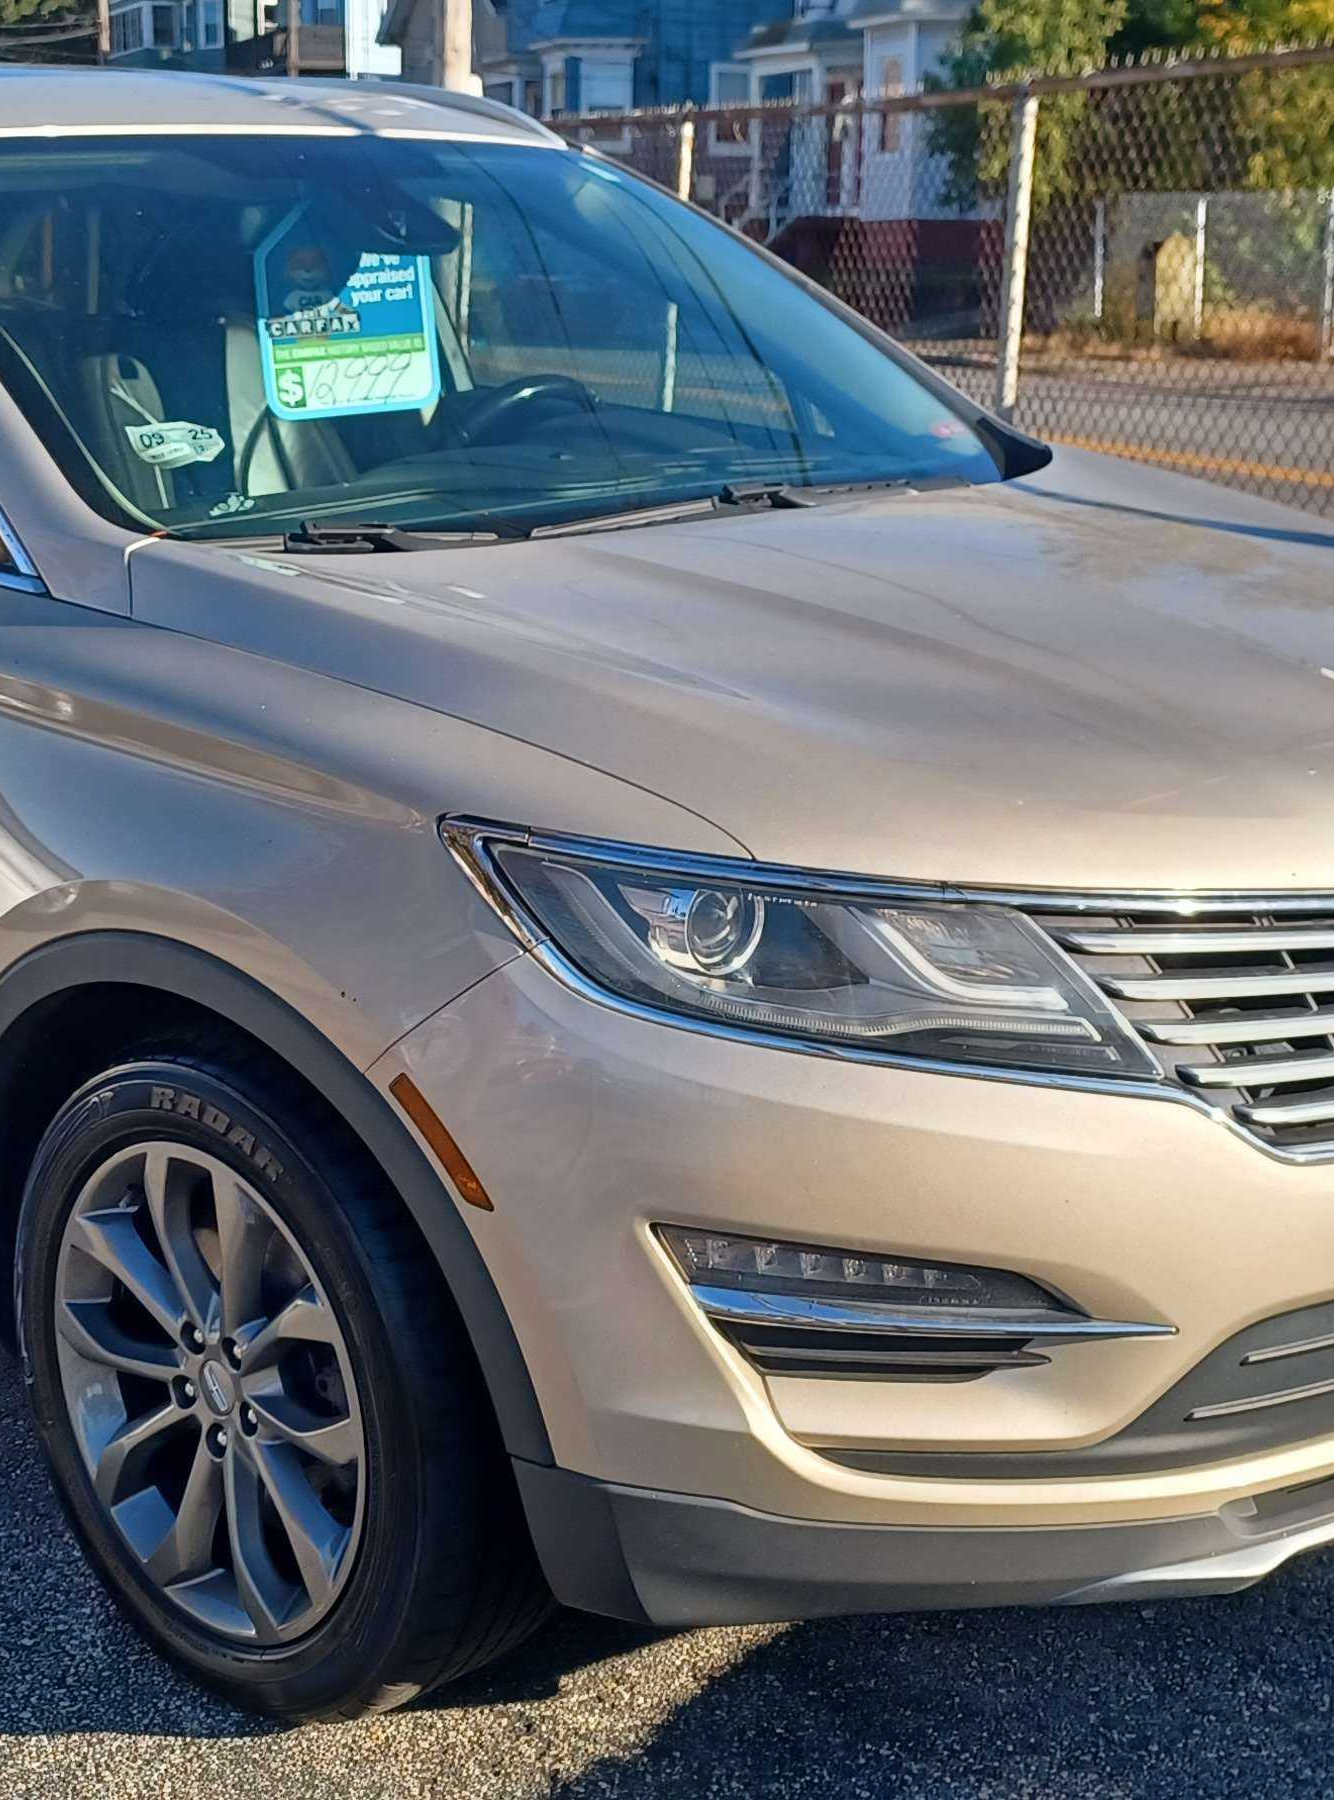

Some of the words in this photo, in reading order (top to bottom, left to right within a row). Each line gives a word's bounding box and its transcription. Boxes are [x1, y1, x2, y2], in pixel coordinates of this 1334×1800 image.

[351, 289, 383, 307] your
[270, 314, 361, 337] CARFAX
[140, 431, 165, 449] 09
[188, 428, 213, 440] 25
[150, 1086, 284, 1182] RADAR
